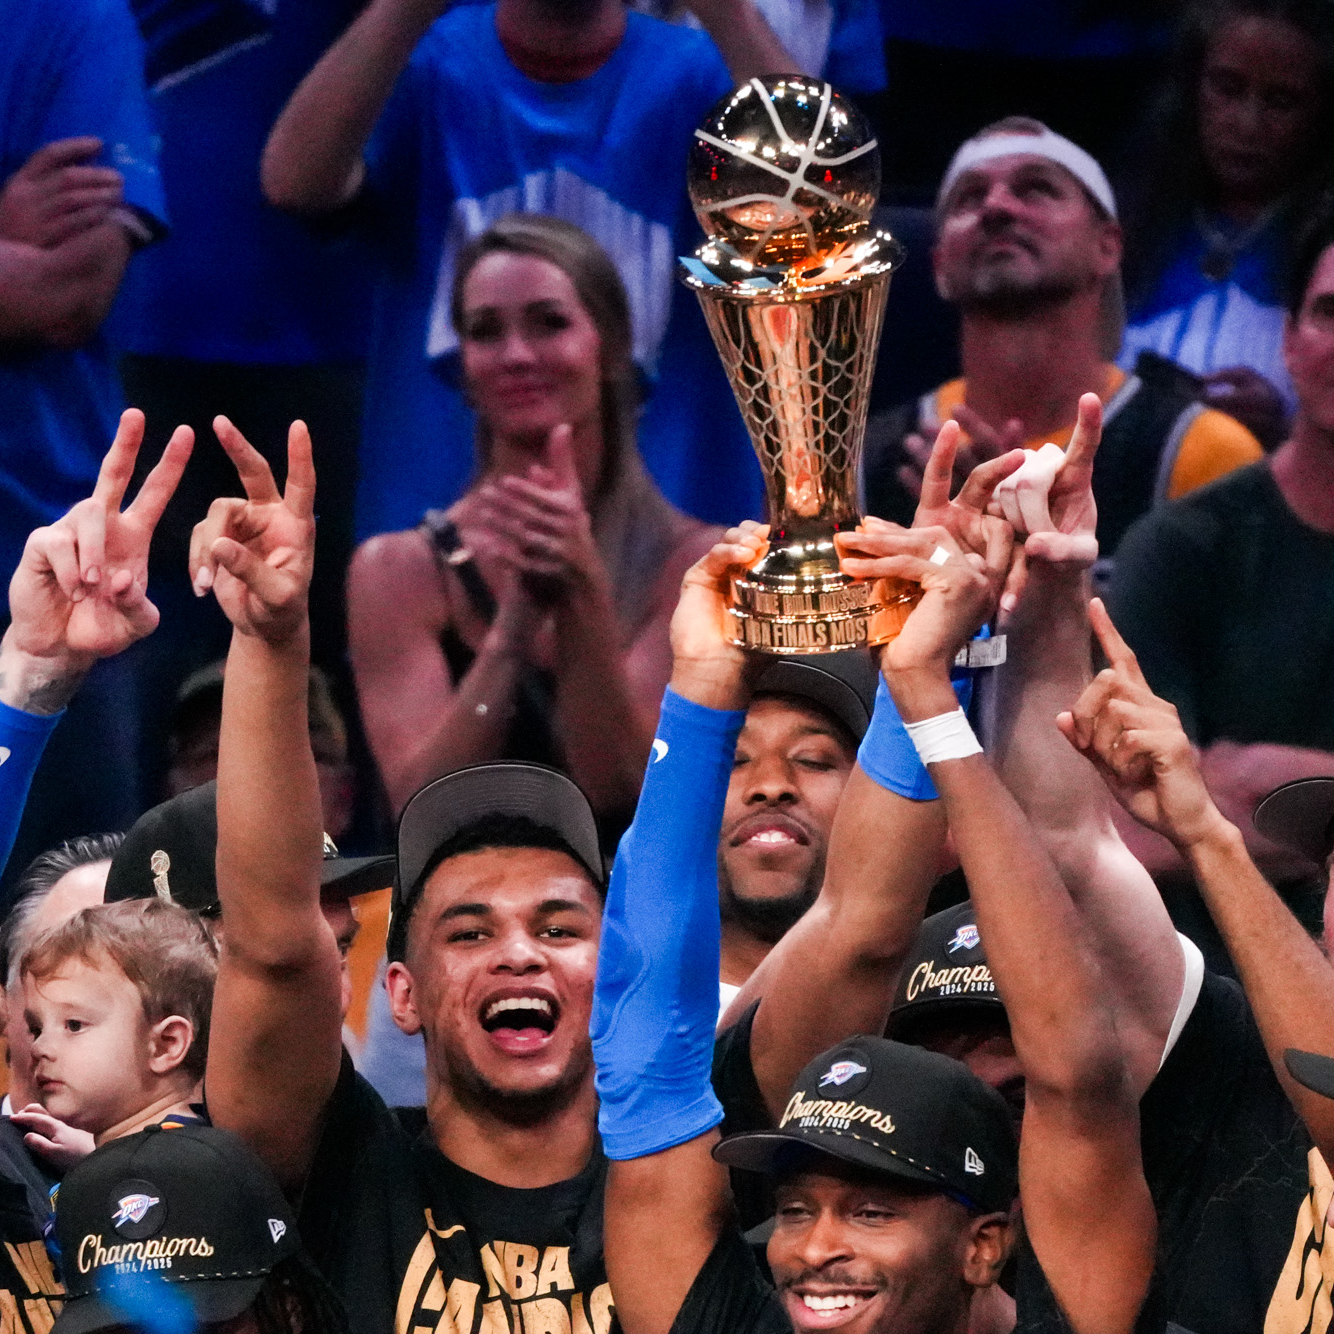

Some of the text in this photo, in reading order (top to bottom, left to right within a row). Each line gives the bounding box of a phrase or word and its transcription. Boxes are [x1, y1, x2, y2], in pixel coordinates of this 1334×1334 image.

[773, 624, 827, 648] FINALS
[779, 1091, 896, 1134] Champions
[78, 1234, 215, 1274] Champions
[479, 1240, 574, 1299] NBA
